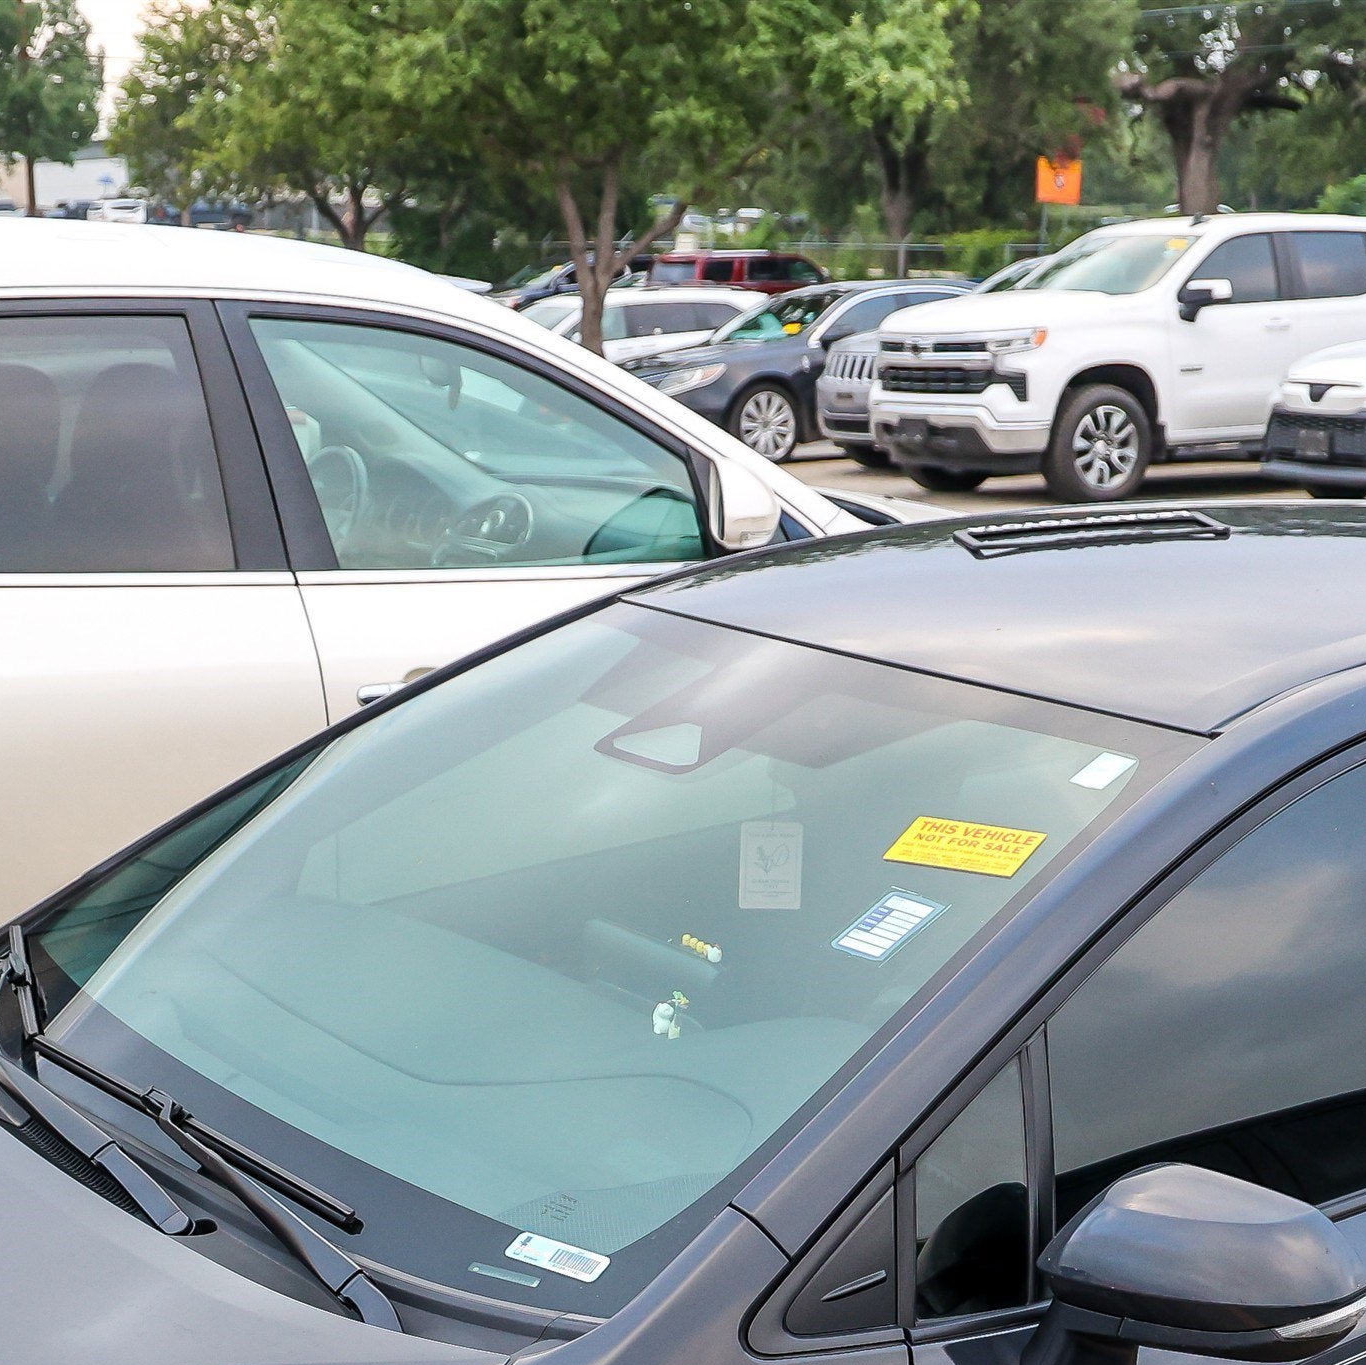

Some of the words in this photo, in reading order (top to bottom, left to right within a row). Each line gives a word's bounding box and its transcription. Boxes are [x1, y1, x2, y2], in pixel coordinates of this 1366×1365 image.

[914, 833, 946, 843] NOT
[947, 837, 981, 848] FOR
[983, 843, 1025, 855] SALE
[919, 821, 960, 835] THIS
[963, 827, 1038, 846] VEHICLE
